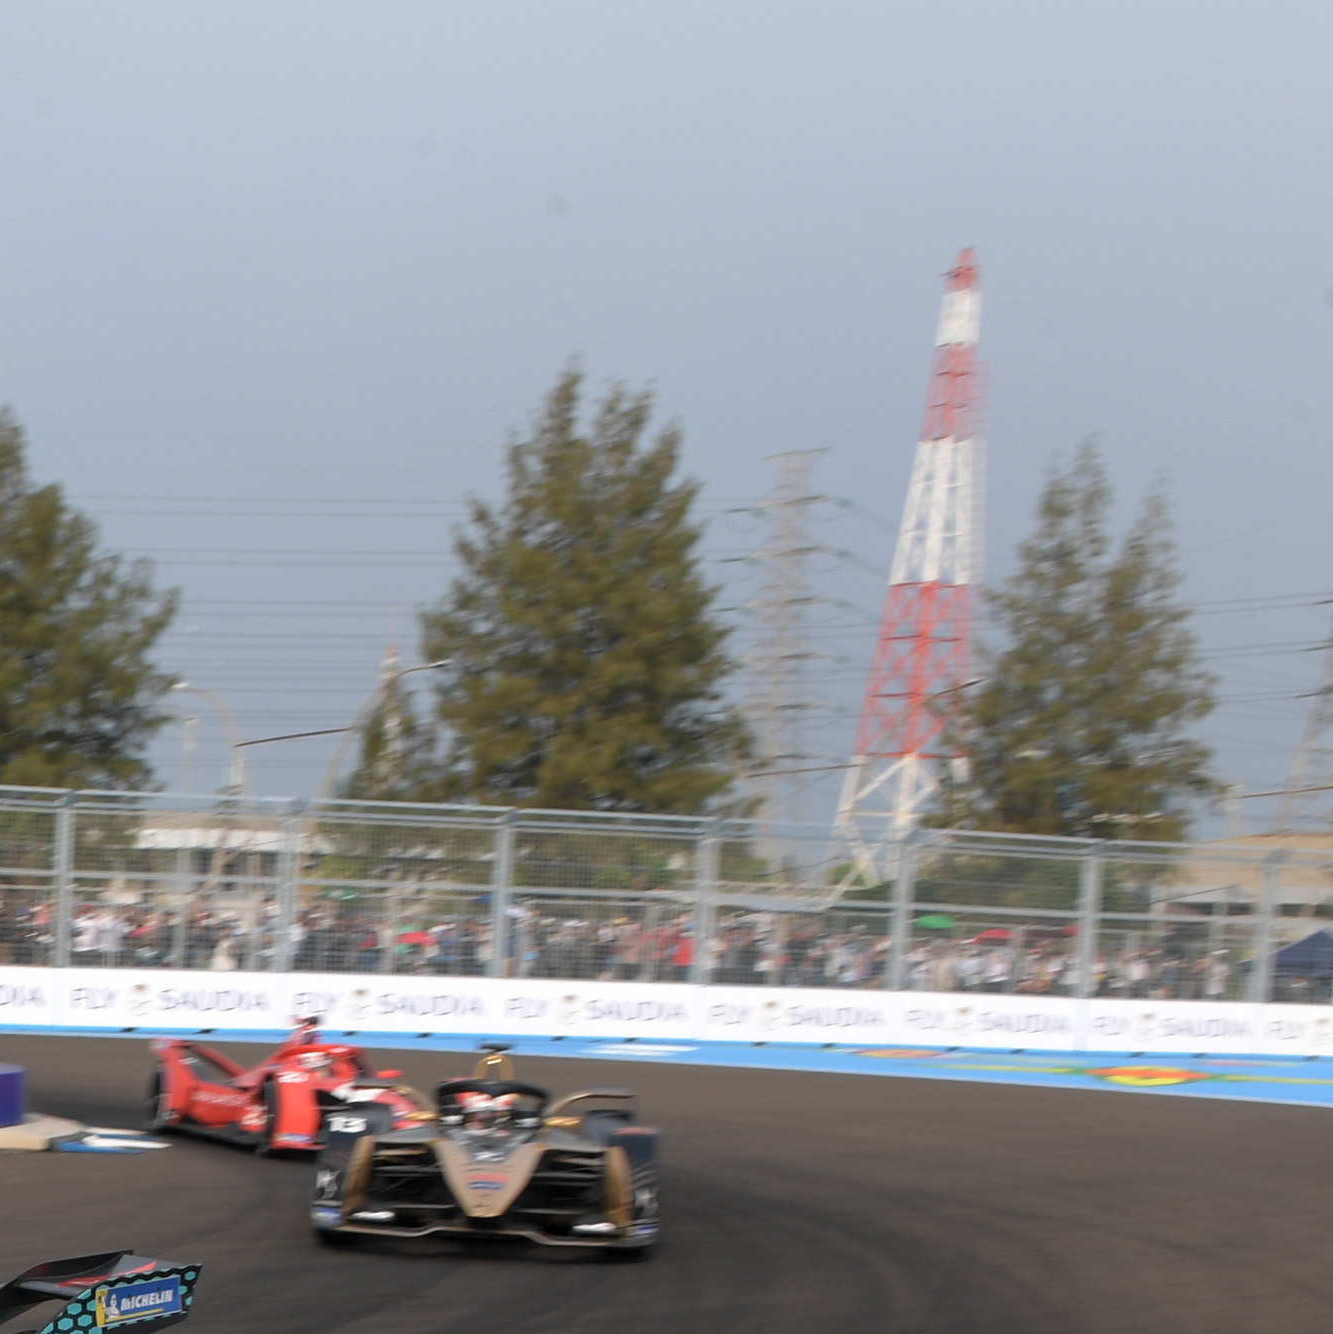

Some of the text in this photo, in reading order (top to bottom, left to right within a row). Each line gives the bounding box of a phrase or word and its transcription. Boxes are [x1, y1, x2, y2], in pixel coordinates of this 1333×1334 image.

[70, 987, 271, 1012] FLY SAUDIA
[120, 1288, 174, 1311] MICHELIN
